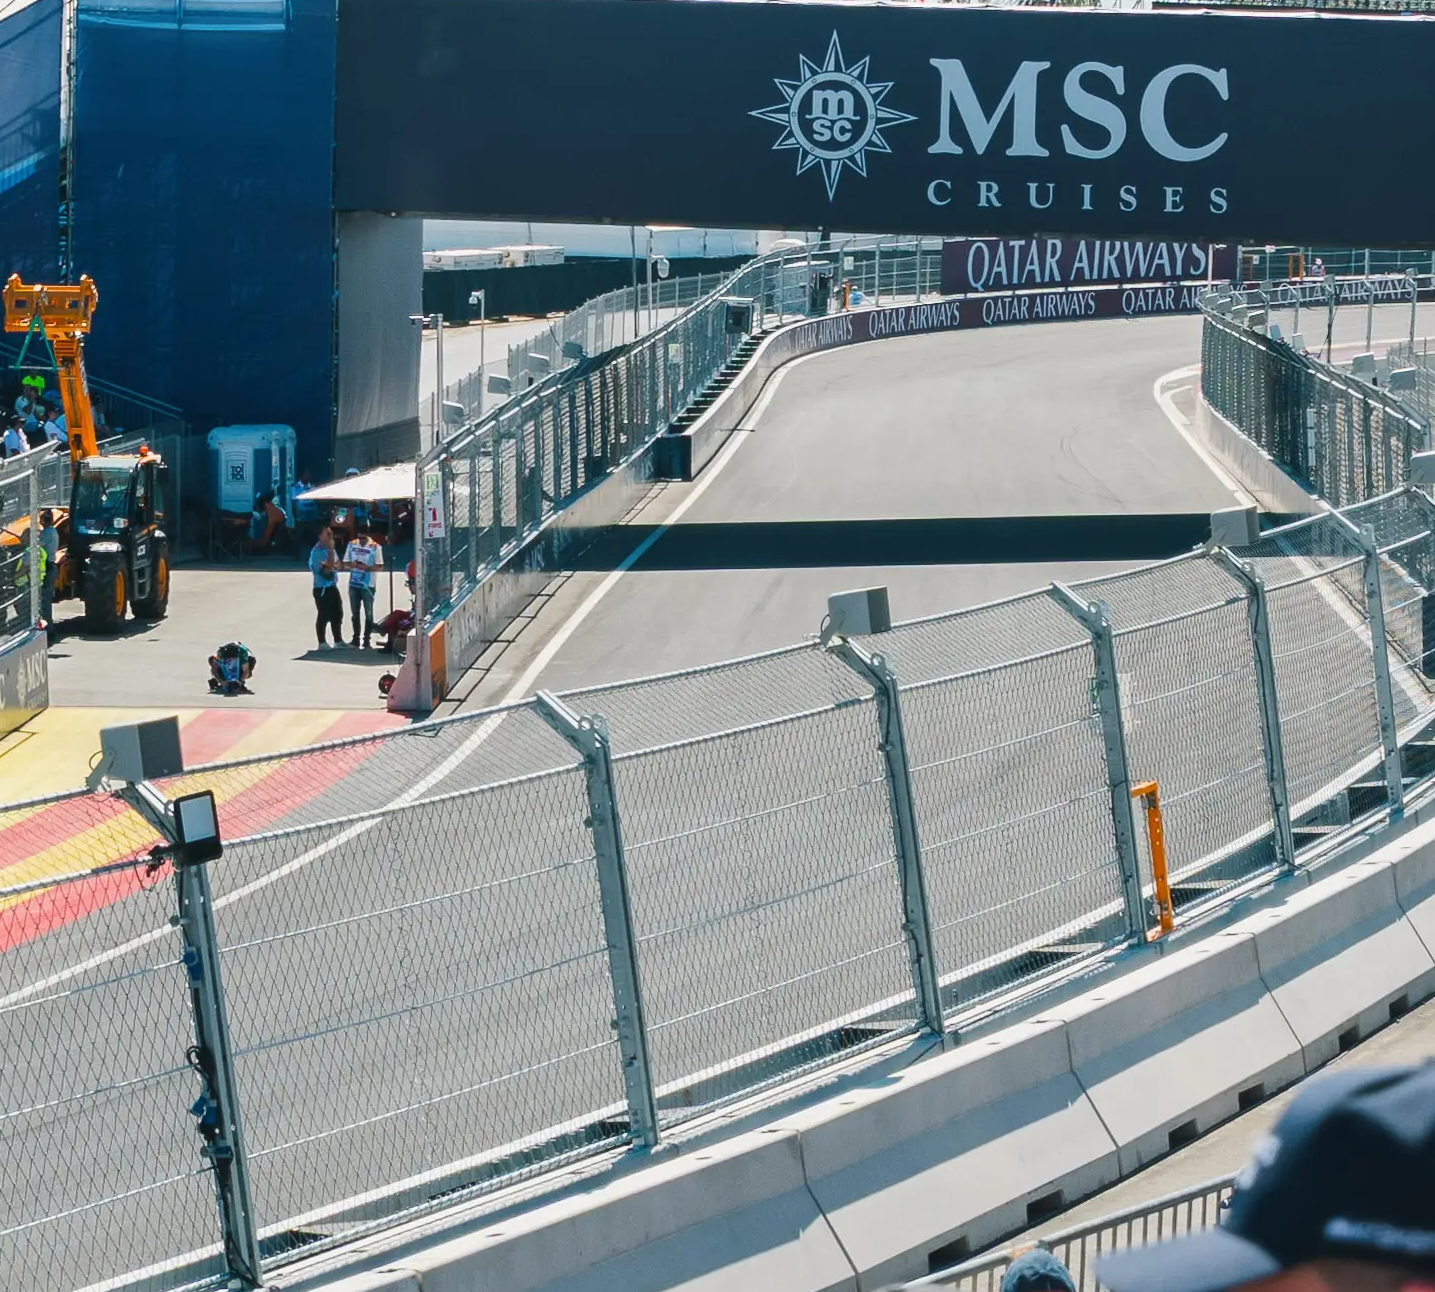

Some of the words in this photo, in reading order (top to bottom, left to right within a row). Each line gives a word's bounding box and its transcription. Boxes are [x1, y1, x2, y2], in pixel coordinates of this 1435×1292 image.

[927, 58, 1229, 162] MSC
[927, 179, 1228, 214] CRUISES
[967, 239, 1063, 291] QATAR
[1070, 240, 1207, 281] AIRWAYS
[982, 297, 1029, 324] QATAR
[1032, 292, 1096, 318] AIRWAYS
[1122, 287, 1174, 314] QATAR
[795, 323, 817, 352] QATAR
[817, 314, 853, 346] AIRWAYS
[868, 308, 906, 337] QATAR
[908, 302, 961, 331] AIRWAYS
[26, 649, 47, 692] MSC
